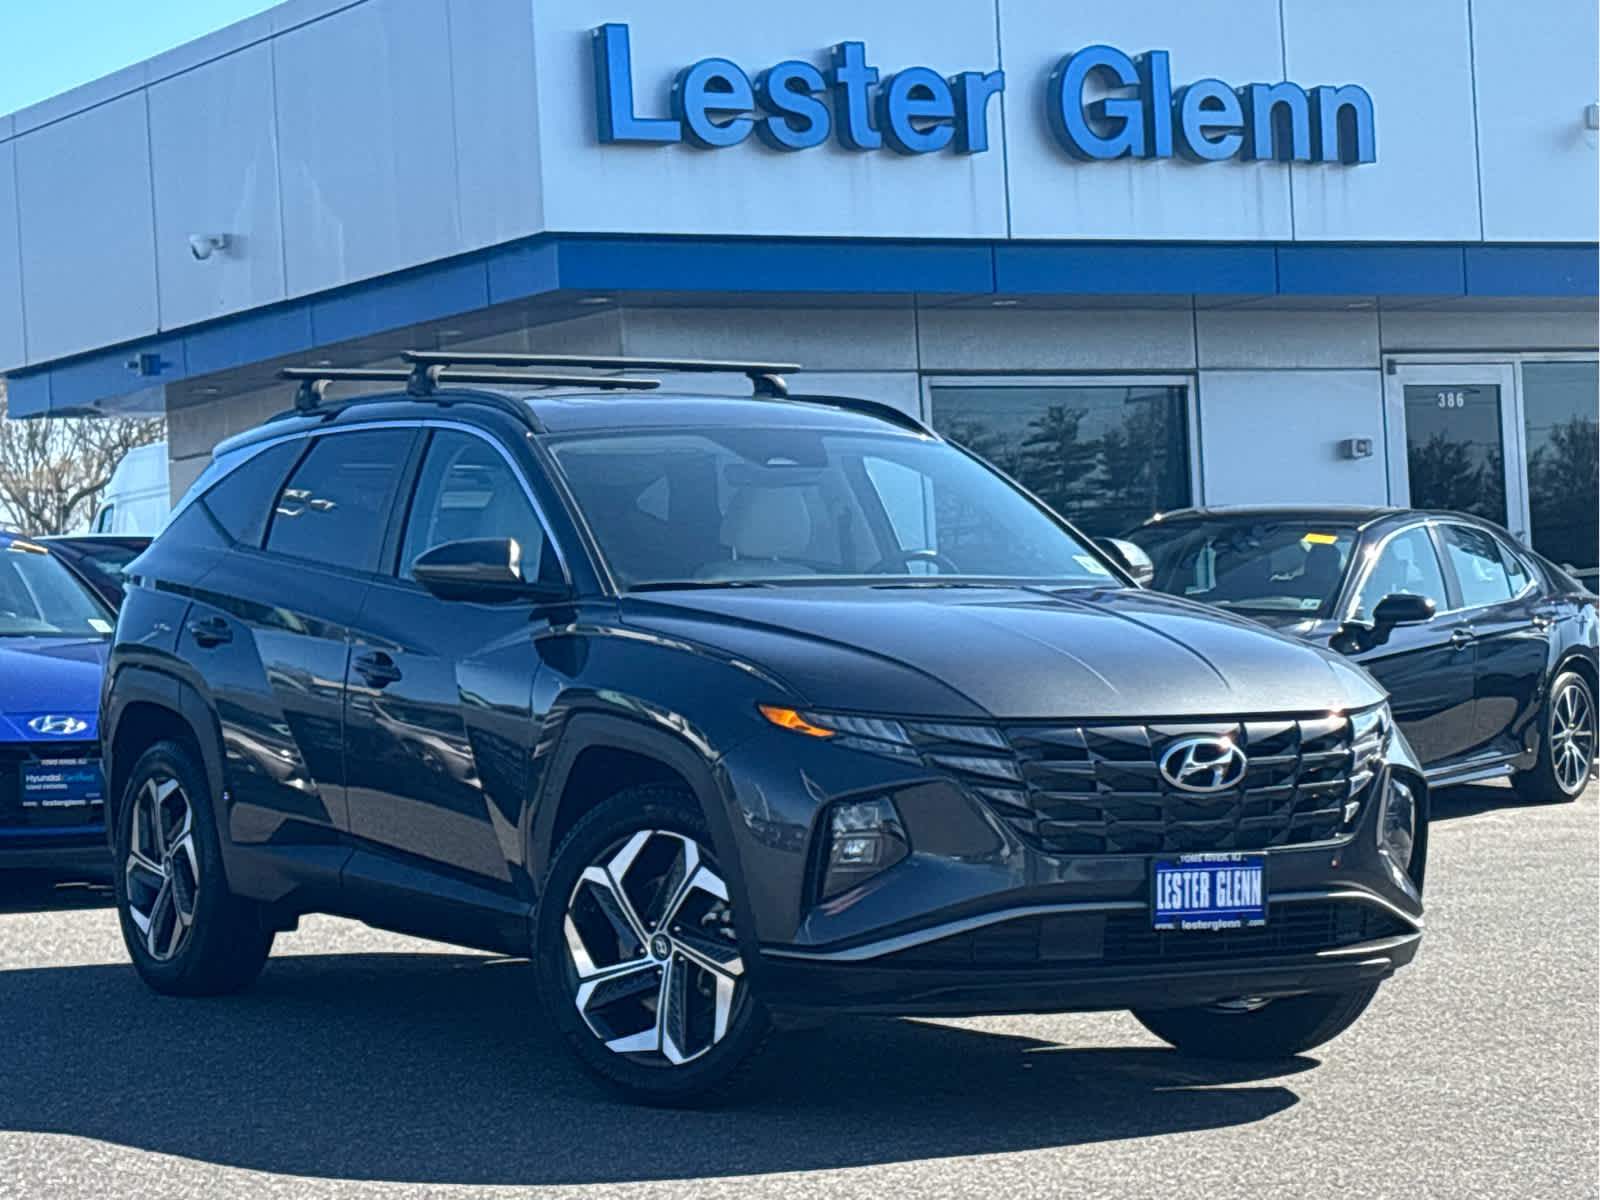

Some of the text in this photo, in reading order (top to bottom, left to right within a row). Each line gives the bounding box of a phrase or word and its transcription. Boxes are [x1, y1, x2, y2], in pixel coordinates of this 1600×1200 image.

[594, 22, 1376, 165] Lester Glenn
[1438, 392, 1464, 408] 386
[25, 774, 62, 782] Hyundai
[1156, 869, 1262, 910] LESTER GLENN
[1181, 917, 1242, 932] lesterglenn
